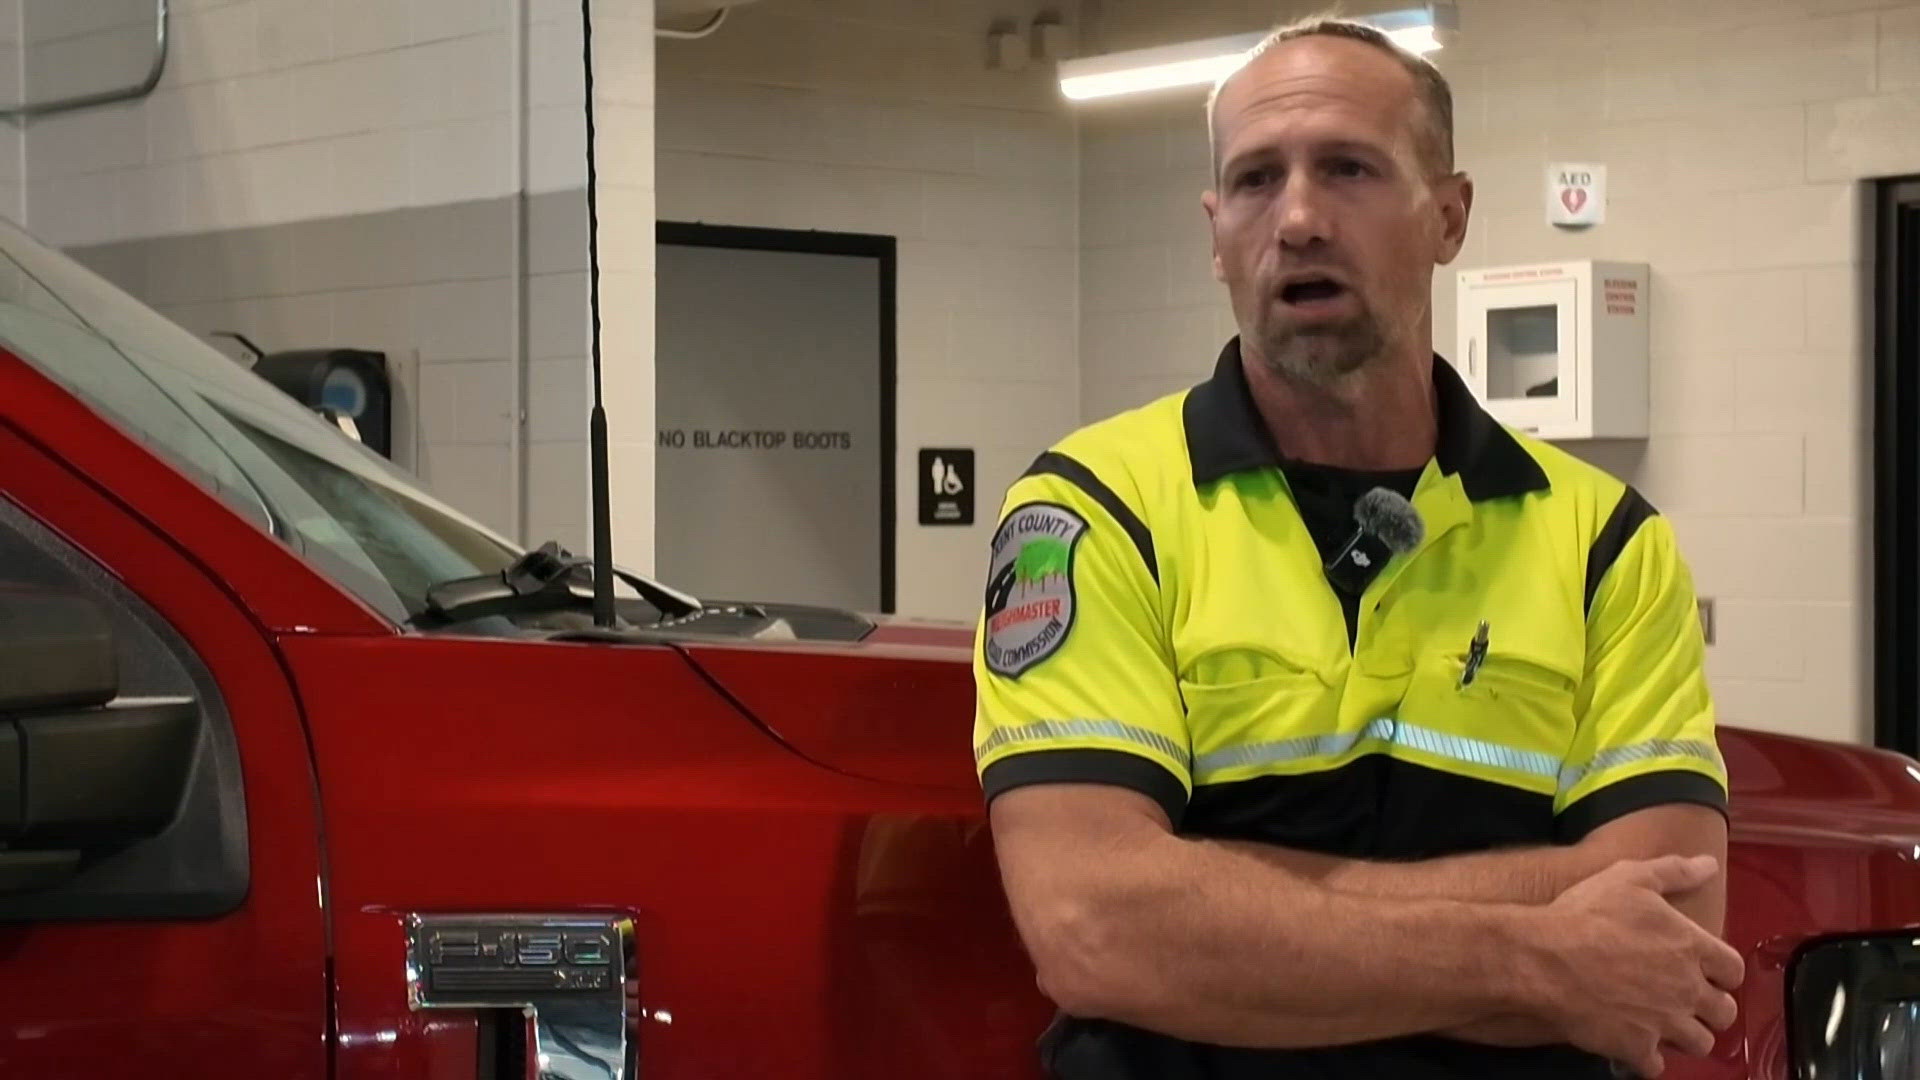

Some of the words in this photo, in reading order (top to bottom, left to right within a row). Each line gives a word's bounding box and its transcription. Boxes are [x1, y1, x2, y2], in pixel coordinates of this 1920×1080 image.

[1559, 171, 1592, 186] AED
[658, 430, 685, 448] NO
[693, 431, 786, 449] BLACKTOP
[792, 432, 851, 450] BOOTS
[1018, 513, 1074, 538] COUNTY
[1002, 615, 1063, 668] COMMISSION
[430, 931, 610, 965] F-150
